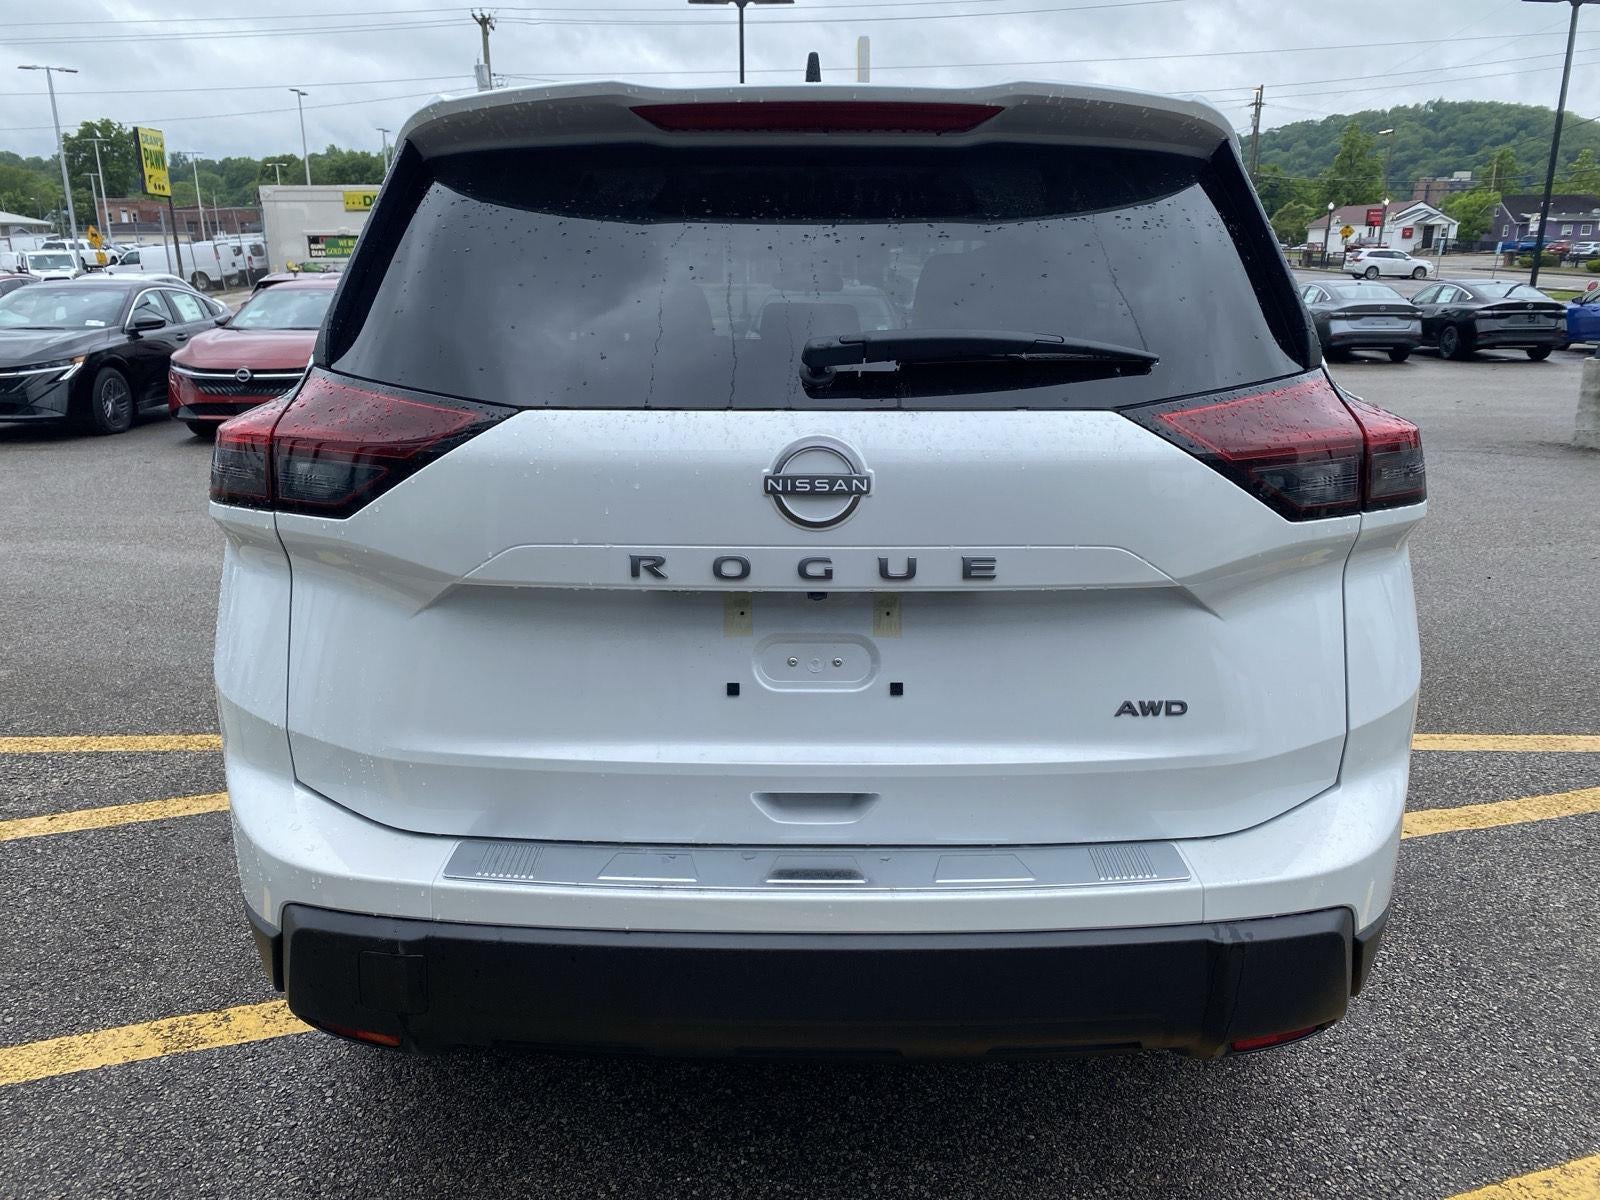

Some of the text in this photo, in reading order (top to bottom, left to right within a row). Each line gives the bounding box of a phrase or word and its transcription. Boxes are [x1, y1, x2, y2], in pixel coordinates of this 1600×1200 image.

[767, 478, 868, 492] NISSAN
[629, 554, 997, 580] ROGUE
[1114, 700, 1188, 717] AWD
